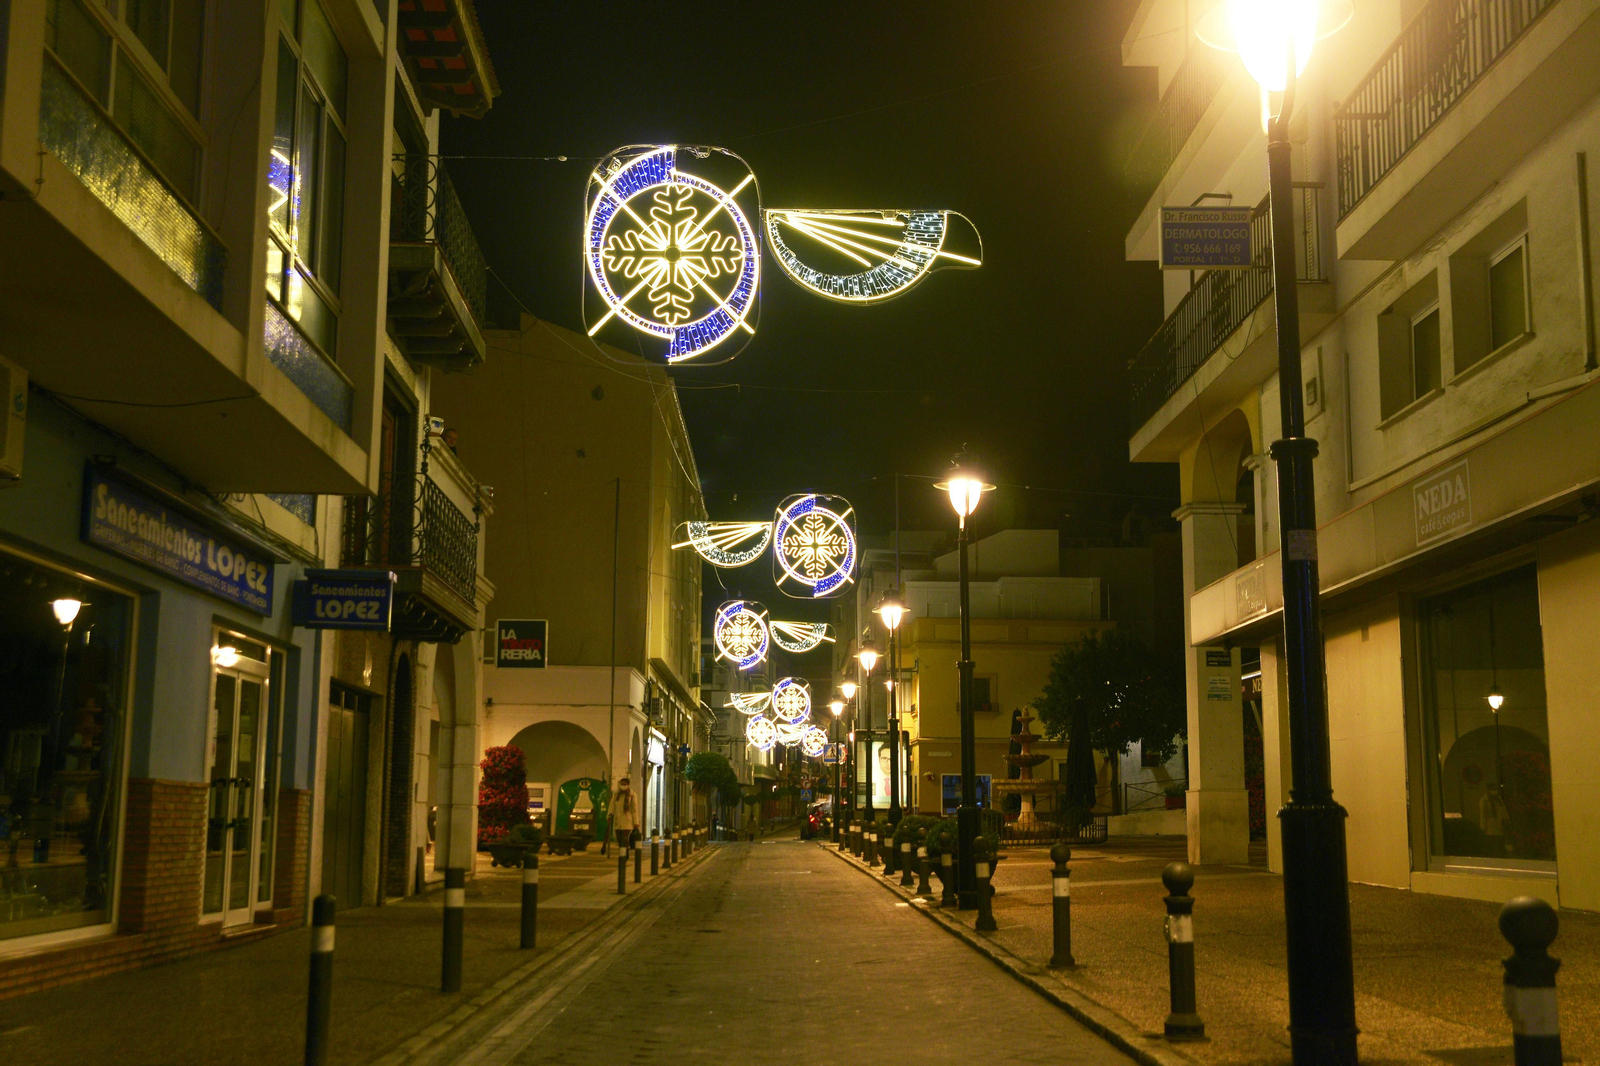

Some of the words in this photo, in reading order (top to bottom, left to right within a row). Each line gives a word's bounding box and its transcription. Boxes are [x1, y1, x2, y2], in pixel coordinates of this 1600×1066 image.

[1164, 212, 1177, 221] Dr.
[1179, 211, 1220, 221] Francisco
[1222, 212, 1247, 221] Russo
[1164, 228, 1249, 239] DERMATOLOGO
[1183, 243, 1201, 253] 956
[1203, 243, 1221, 253] 666
[1224, 243, 1241, 253] 169
[1416, 474, 1467, 519] NEDA
[95, 483, 202, 565] Saneamientos
[207, 539, 268, 595] LOPEZ
[311, 583, 387, 598] Saneamientos
[315, 599, 381, 620] LOPEZ
[501, 629, 518, 640] LA
[501, 639, 542, 650] TINTO
[1252, 678, 1262, 693] NE
